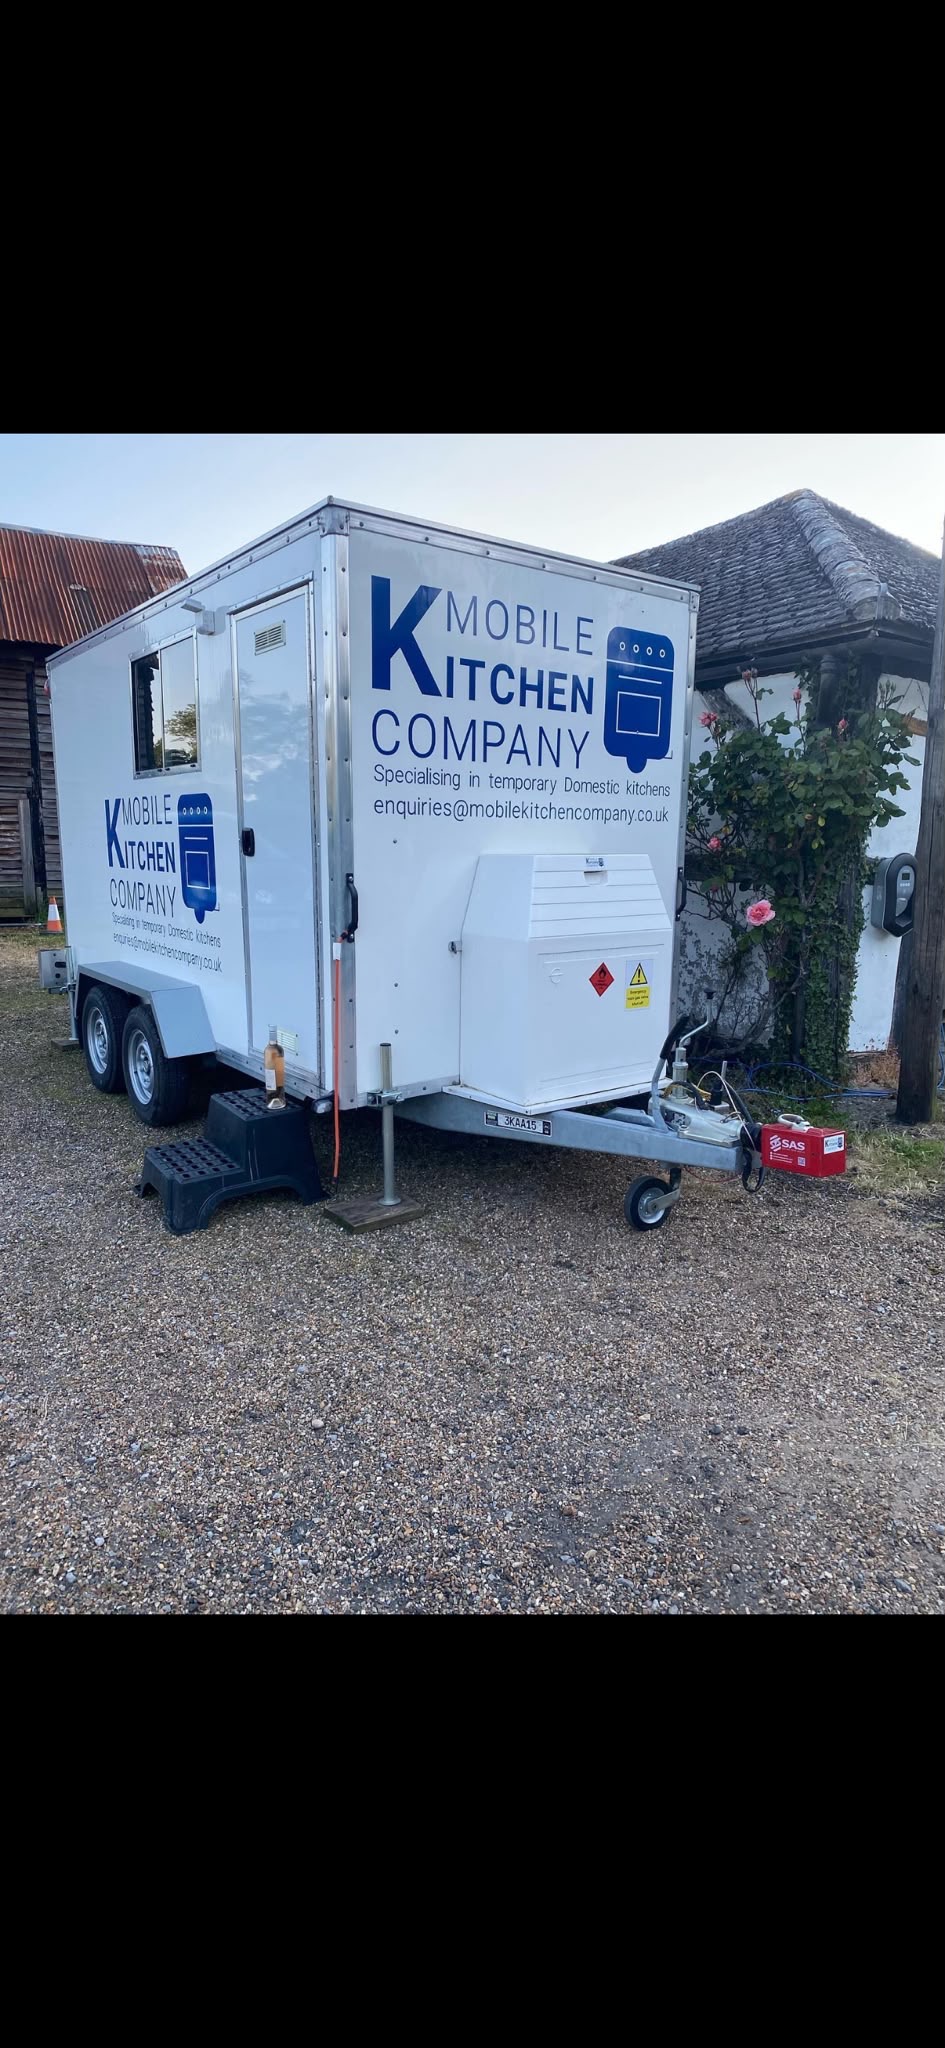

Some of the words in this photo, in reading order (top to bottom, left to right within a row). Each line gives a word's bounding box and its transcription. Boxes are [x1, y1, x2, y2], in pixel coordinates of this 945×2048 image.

[447, 591, 594, 656] MOBILE
[371, 575, 594, 715] KITCHEN
[371, 709, 590, 769] COMPANY
[373, 764, 461, 790] Specialising
[469, 771, 480, 788] in
[489, 773, 557, 795] temporary
[564, 777, 620, 795] Domestic
[626, 779, 671, 797] kitchens
[122, 794, 173, 826] MOBILE
[373, 797, 669, 825] enquiries@mobilekitchencompany.co.uk
[105, 798, 176, 873] KITCHEN
[110, 879, 176, 918] COMPANY
[142, 919, 166, 937] temporary
[168, 923, 194, 941] Domestic
[196, 929, 221, 948] kitchens
[504, 1116, 537, 1131] 3KAA15
[781, 1139, 806, 1151] SAS
